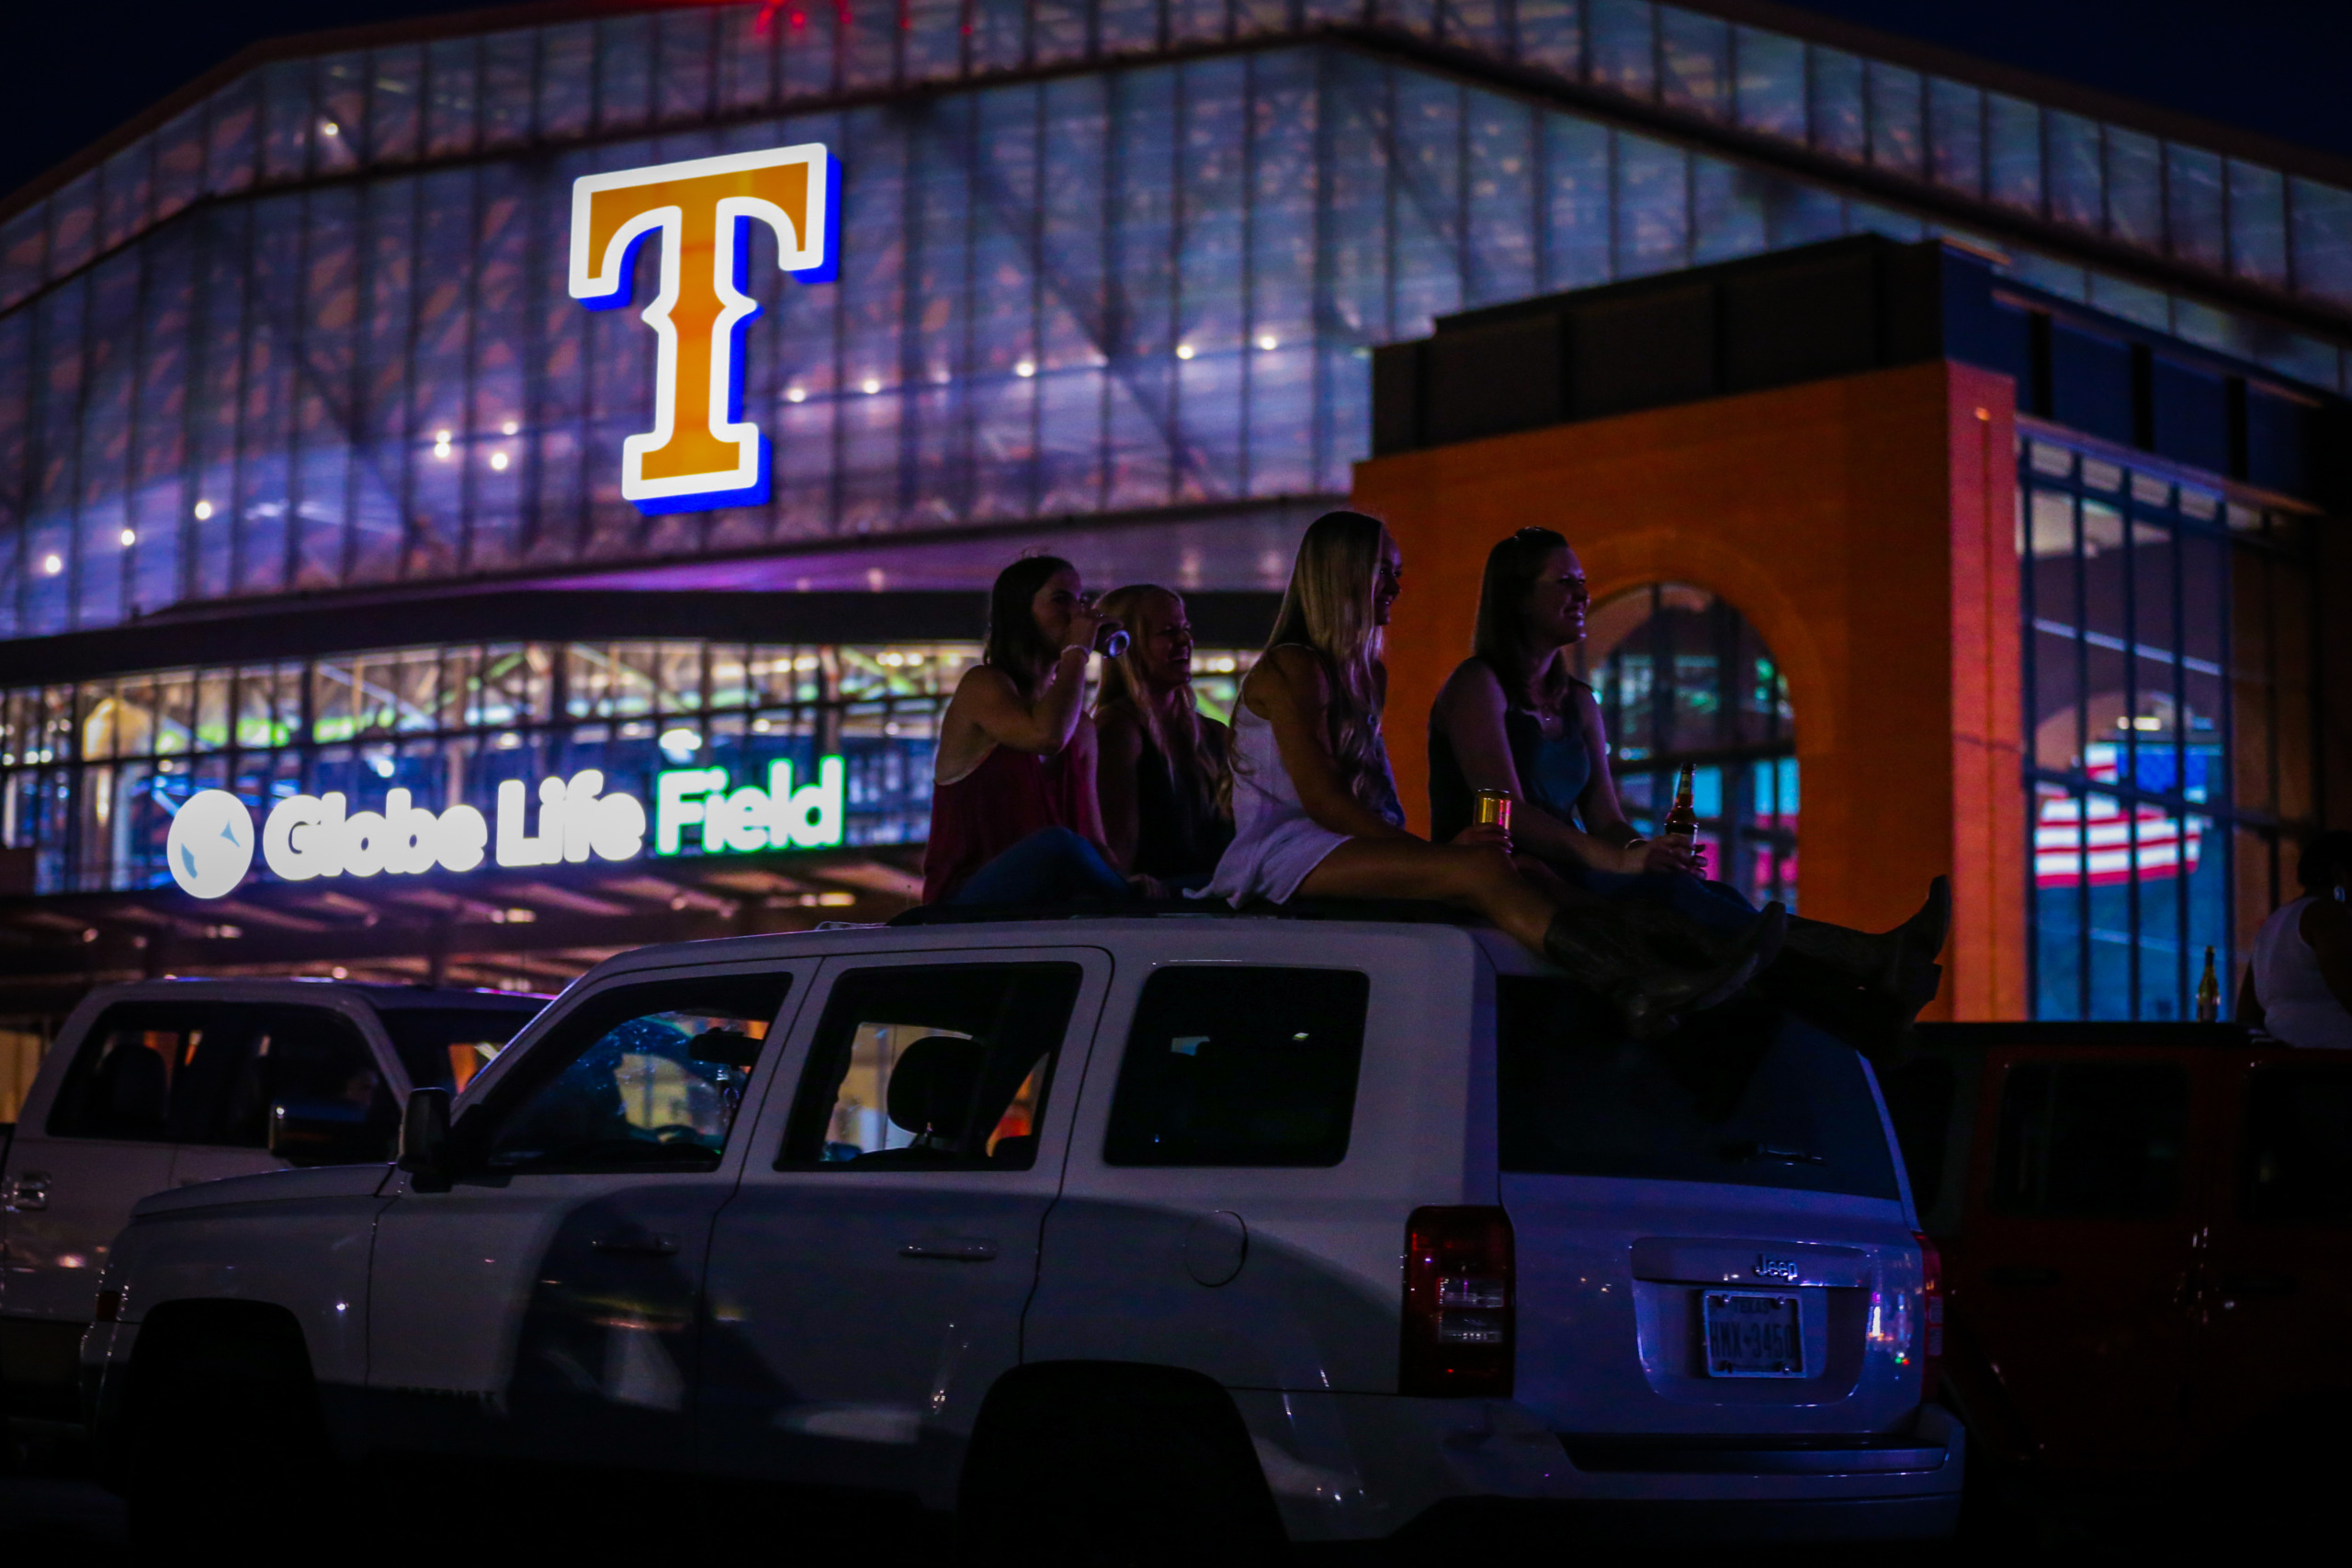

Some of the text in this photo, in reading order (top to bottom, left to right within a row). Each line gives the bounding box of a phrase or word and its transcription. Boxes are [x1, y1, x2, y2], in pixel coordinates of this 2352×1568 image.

[569, 142, 838, 511] T
[263, 756, 843, 881] Globe Life Field
[1754, 1253, 1798, 1280] Jeep
